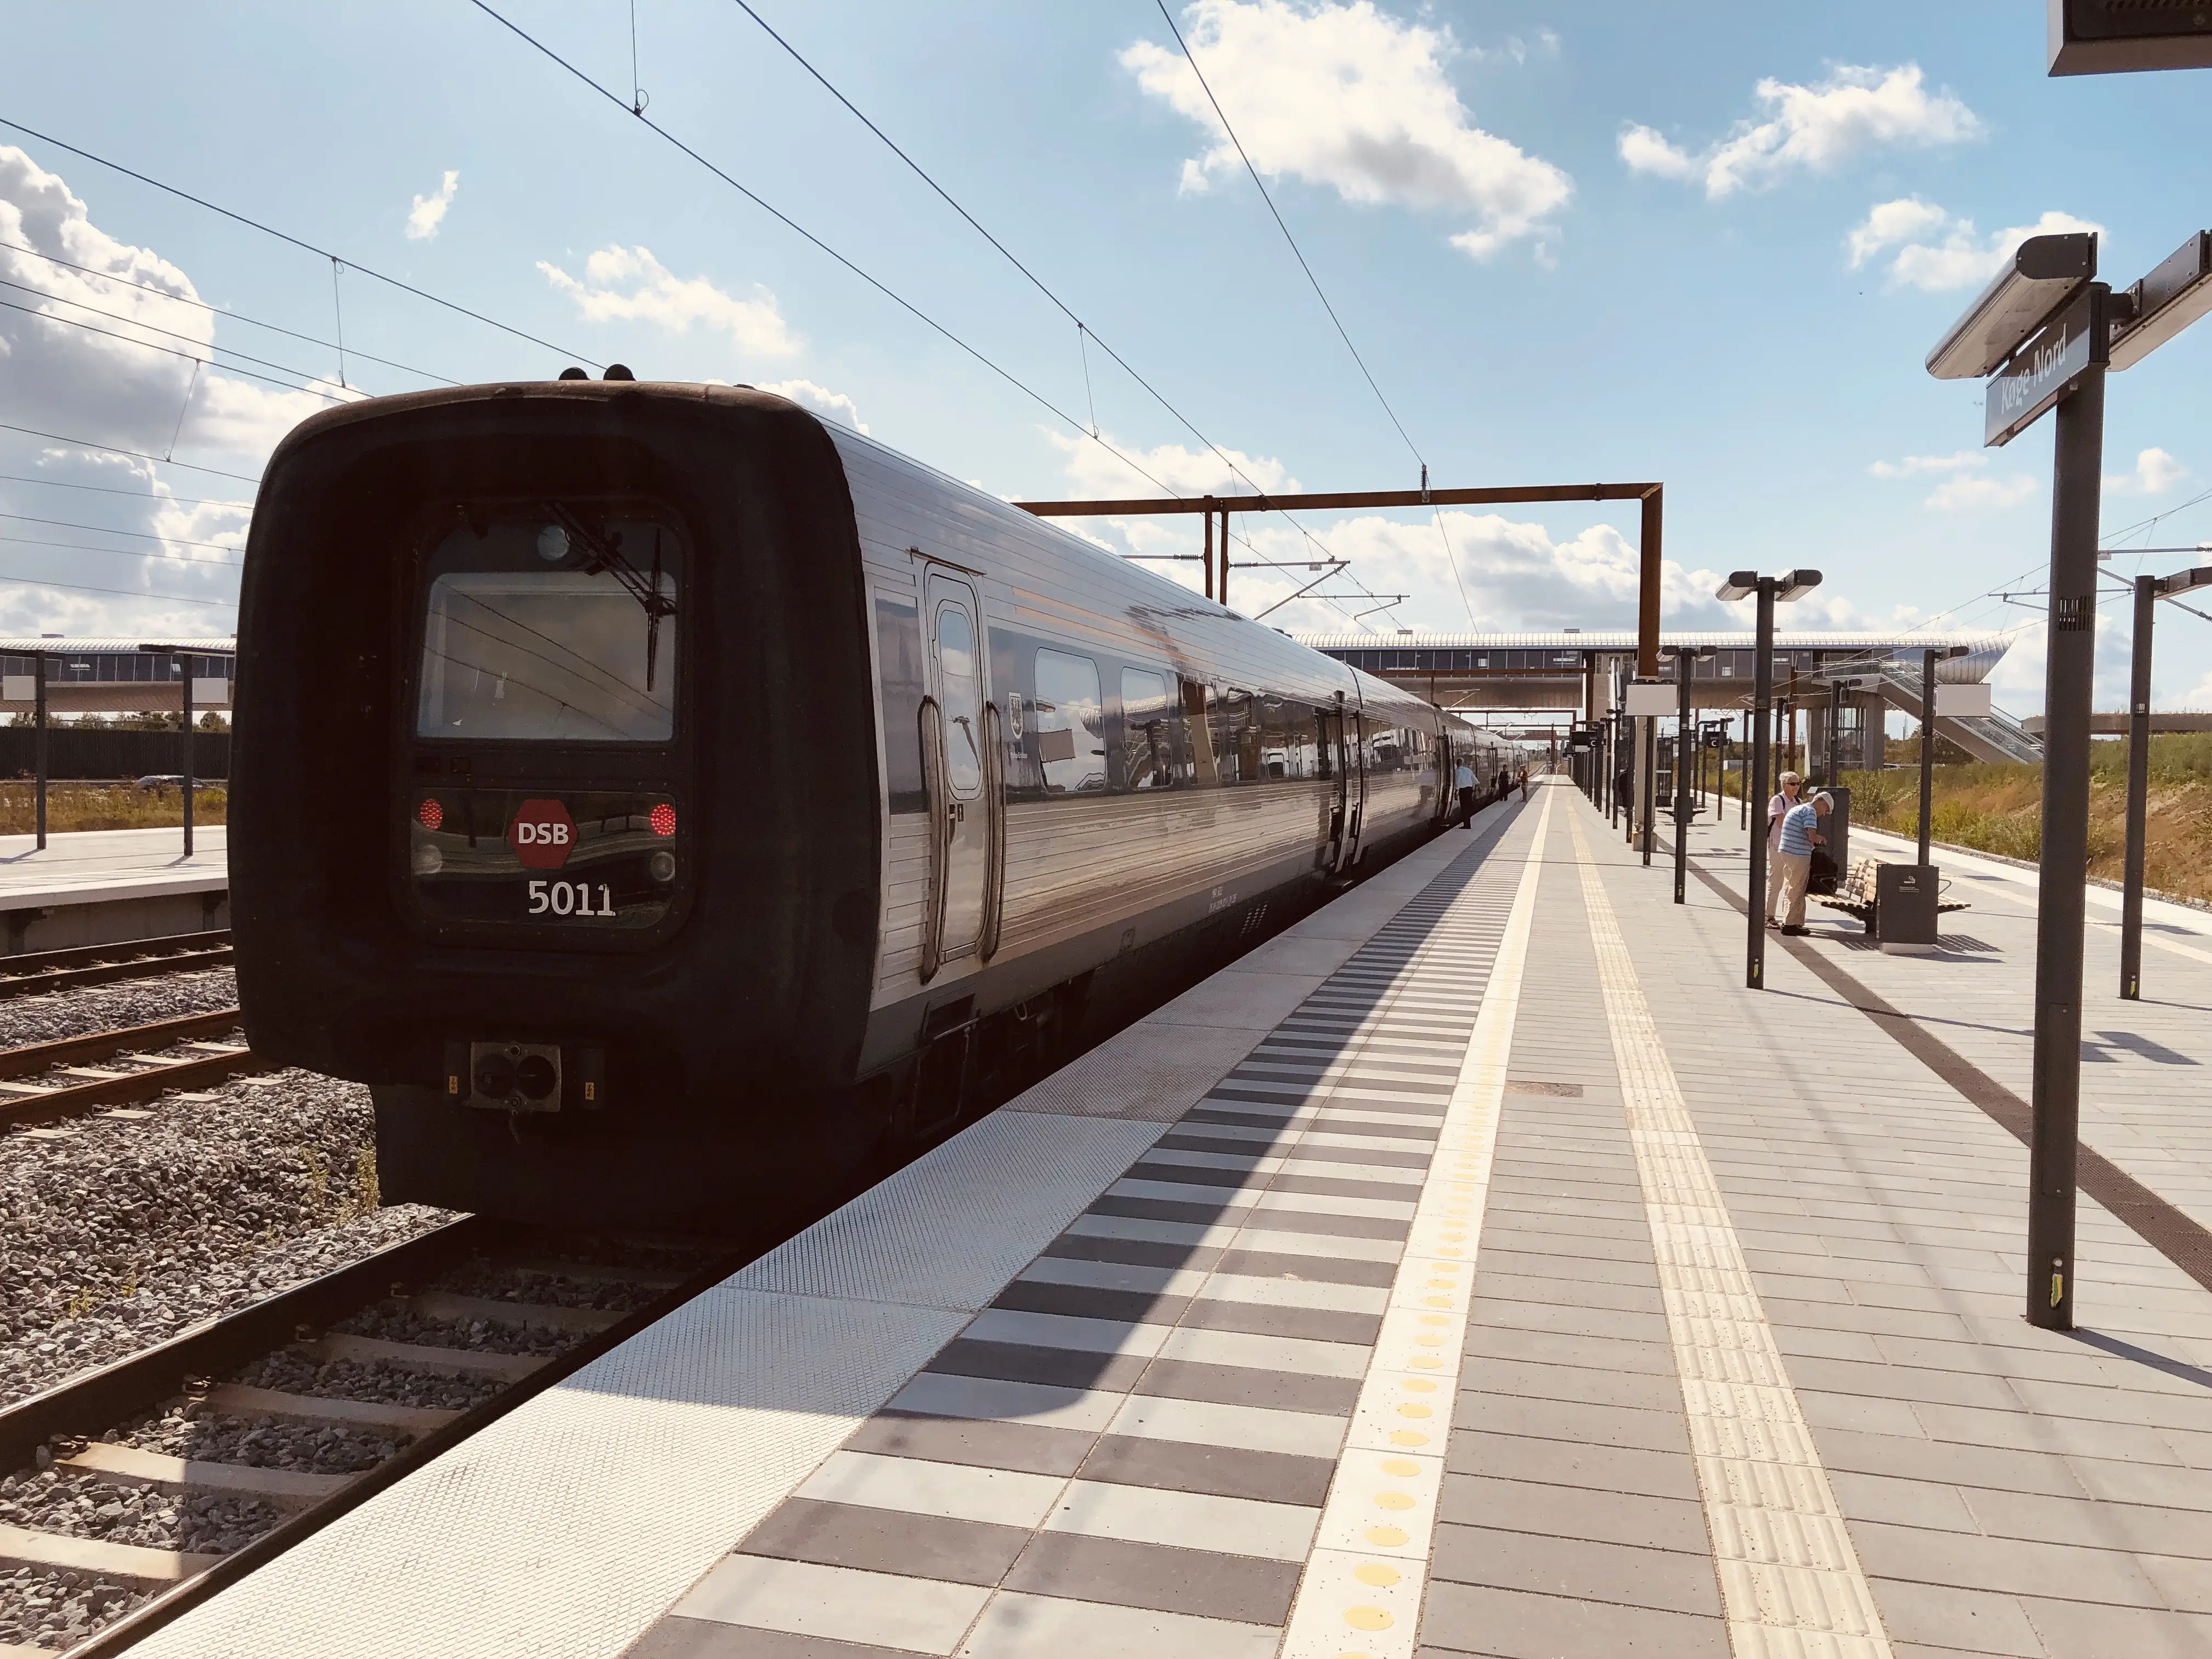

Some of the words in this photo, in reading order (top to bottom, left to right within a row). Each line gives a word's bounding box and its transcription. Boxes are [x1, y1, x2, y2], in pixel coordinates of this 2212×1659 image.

[2001, 368, 2030, 414] Køge
[2034, 323, 2067, 387] Nord
[518, 822, 569, 845] DSB
[528, 880, 616, 916] 5011
